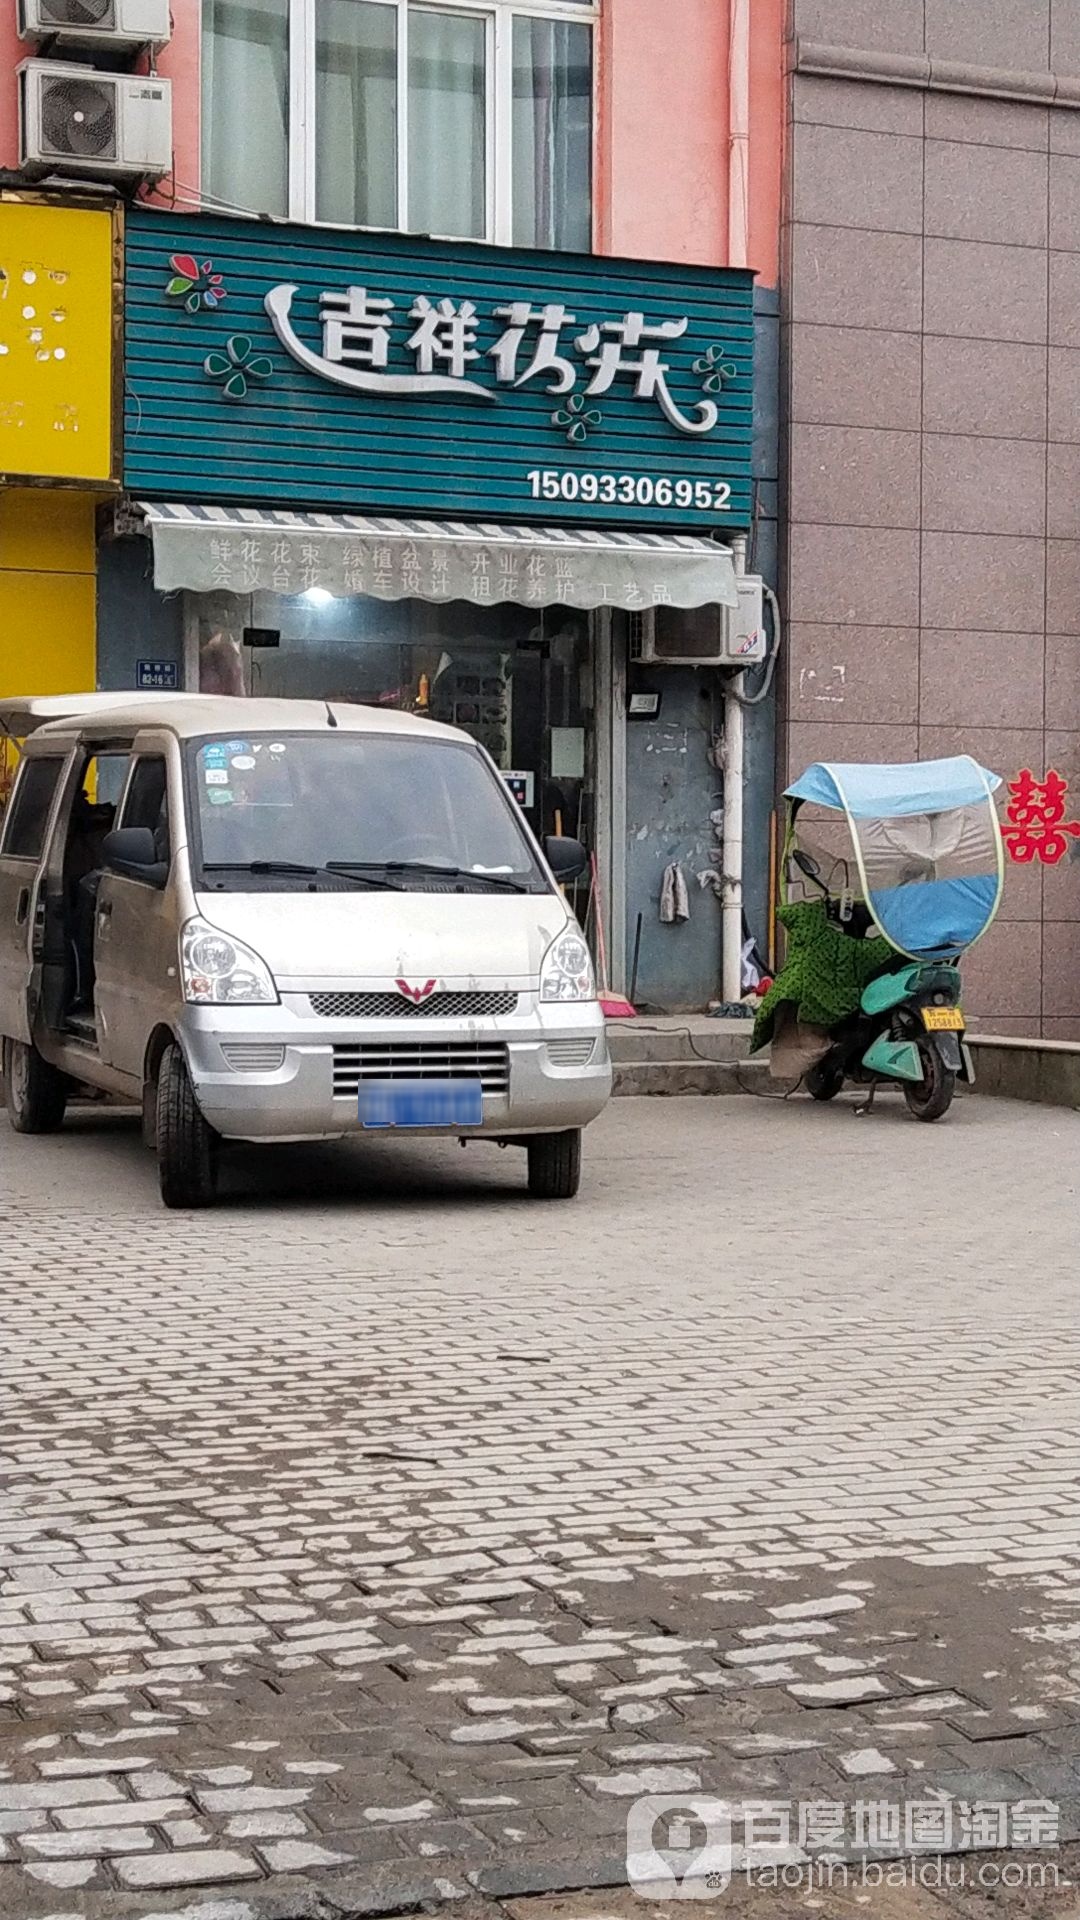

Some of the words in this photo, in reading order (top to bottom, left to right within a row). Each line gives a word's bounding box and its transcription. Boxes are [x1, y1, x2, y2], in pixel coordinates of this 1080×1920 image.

[264, 284, 718, 434] 吉祥花卉
[527, 470, 731, 510] 15093306952
[210, 538, 321, 565] 鲜花花束
[342, 544, 450, 572] 绿植盆景
[470, 552, 575, 578] 开业花篮
[210, 562, 322, 588] 会议台花
[343, 569, 451, 594] 婚车设计
[470, 575, 575, 599] 租花养护
[597, 582, 672, 603] 工艺品
